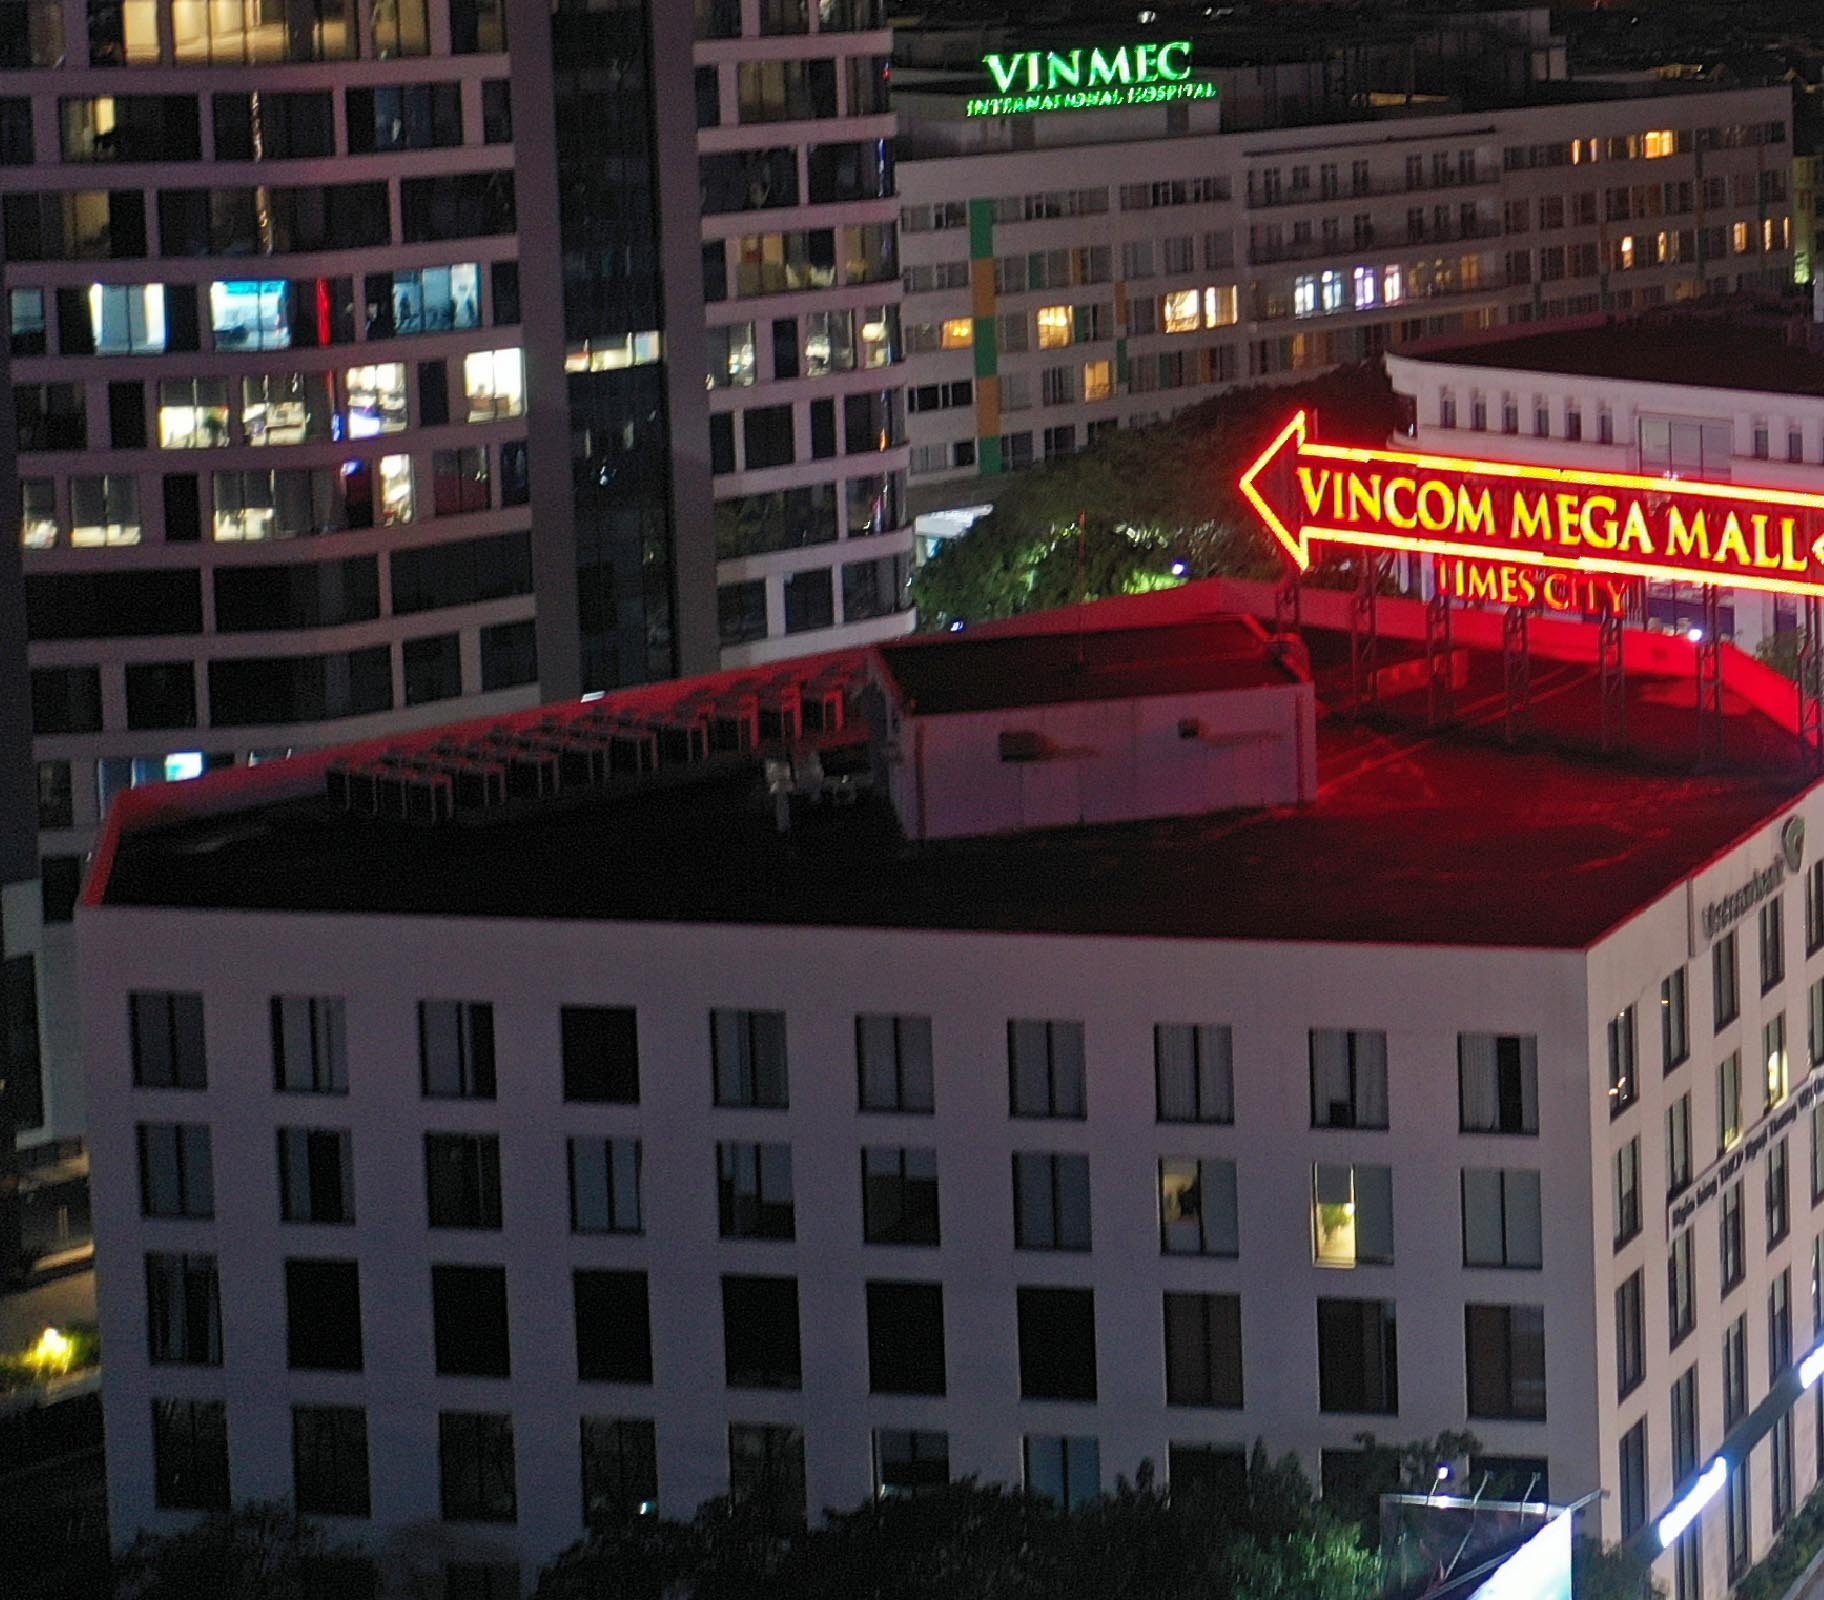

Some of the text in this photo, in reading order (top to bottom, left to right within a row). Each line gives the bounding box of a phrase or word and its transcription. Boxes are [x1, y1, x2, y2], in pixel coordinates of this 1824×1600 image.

[982, 41, 1191, 94] VINMEC
[1297, 467, 1808, 572] VINCOM MEGA MALL
[1435, 557, 1626, 617] TIMES CITY
